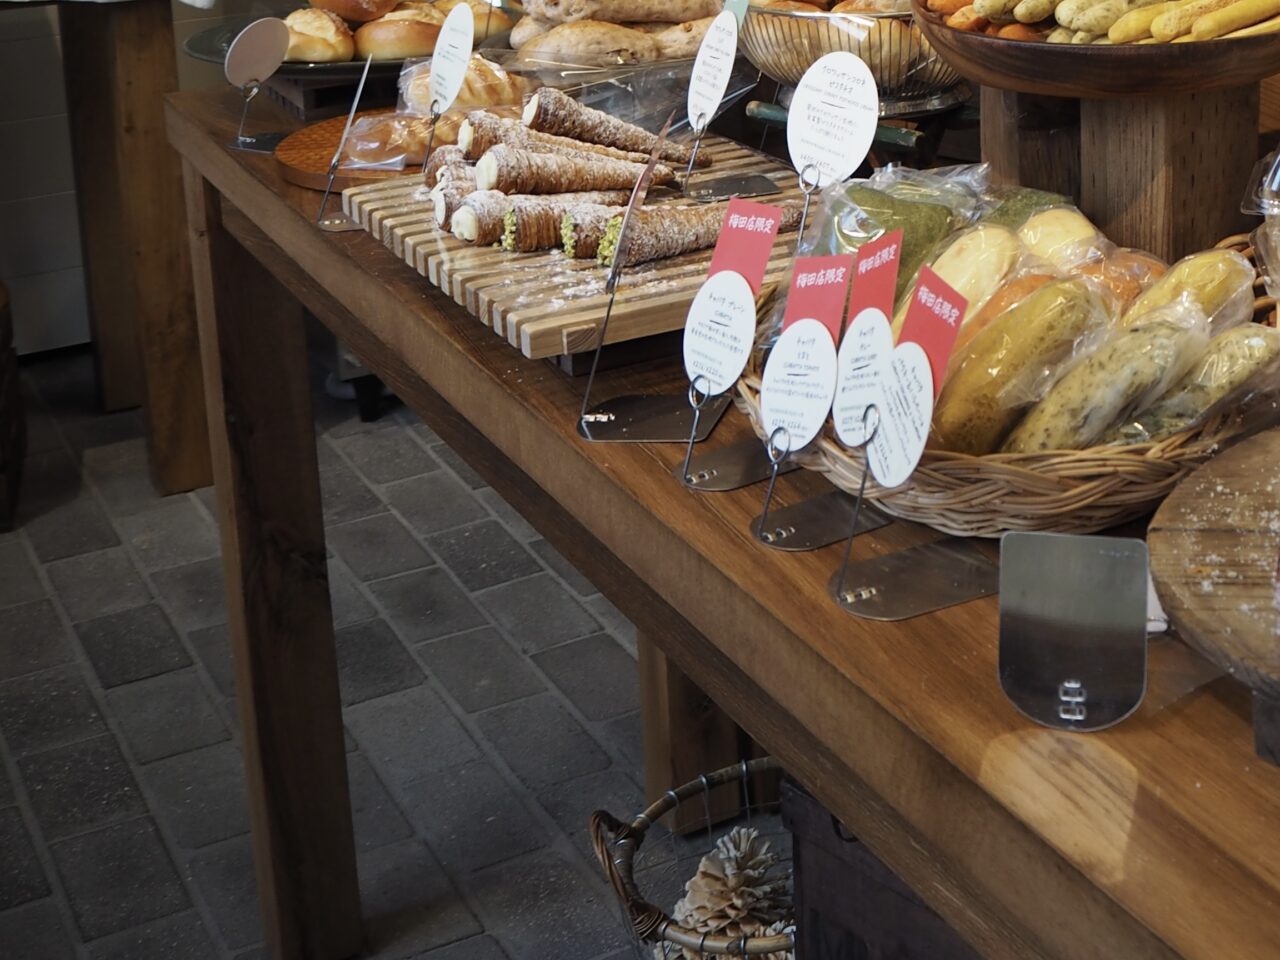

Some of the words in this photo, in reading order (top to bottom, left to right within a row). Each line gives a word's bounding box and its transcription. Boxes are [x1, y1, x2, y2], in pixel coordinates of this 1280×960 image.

[728, 213, 775, 235] 梅田店限定
[858, 244, 898, 275] 梅田店限定
[796, 267, 847, 289] 梅田店限定
[917, 284, 961, 327] 梅田店限定
